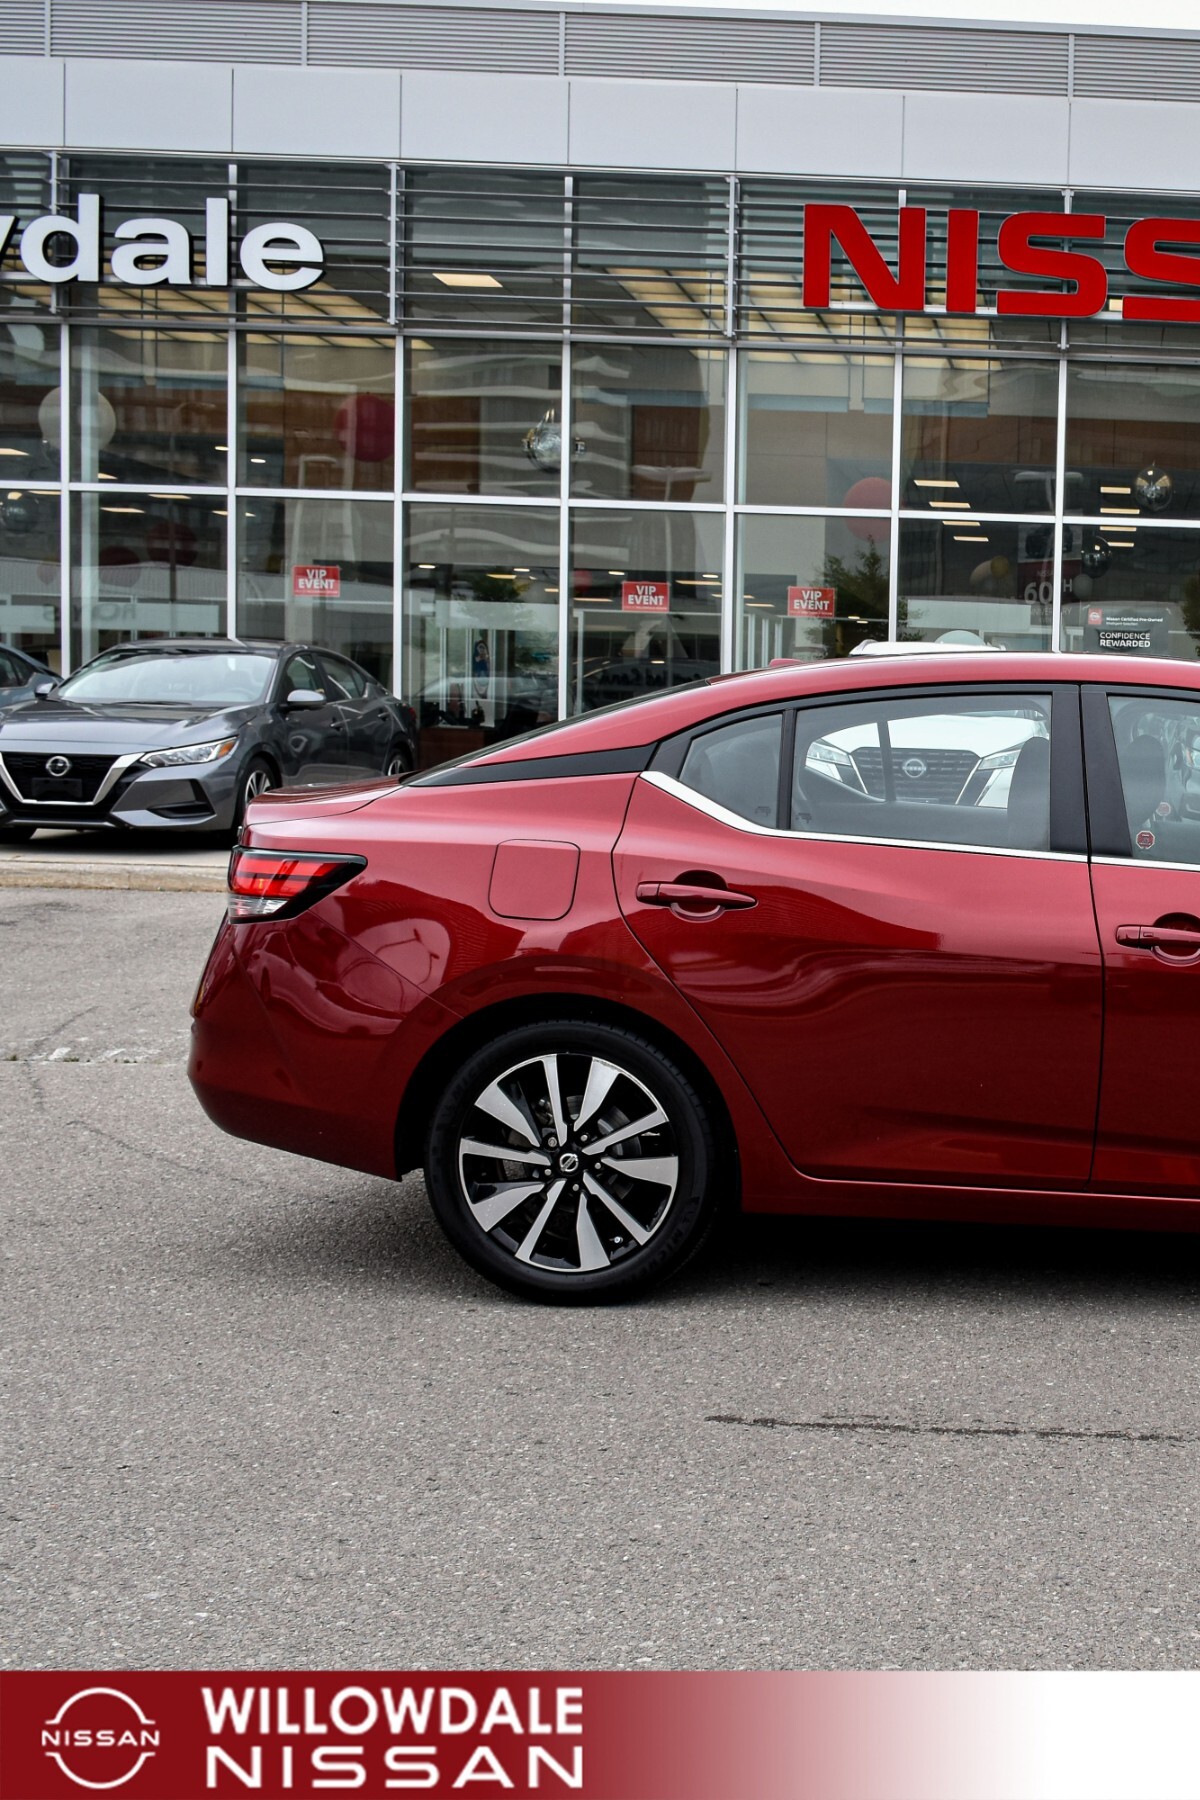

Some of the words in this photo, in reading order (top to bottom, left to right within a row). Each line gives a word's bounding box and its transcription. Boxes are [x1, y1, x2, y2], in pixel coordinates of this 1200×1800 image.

[0, 193, 325, 291] dale
[306, 569, 327, 579] VIP
[298, 578, 336, 589] EVENT
[636, 585, 656, 595] VIP
[801, 590, 822, 600] VIP
[627, 594, 664, 605] EVENT
[793, 599, 830, 610] EVENT
[1100, 632, 1151, 640] CONFIDENCE
[1100, 639, 1151, 648] REWARDED
